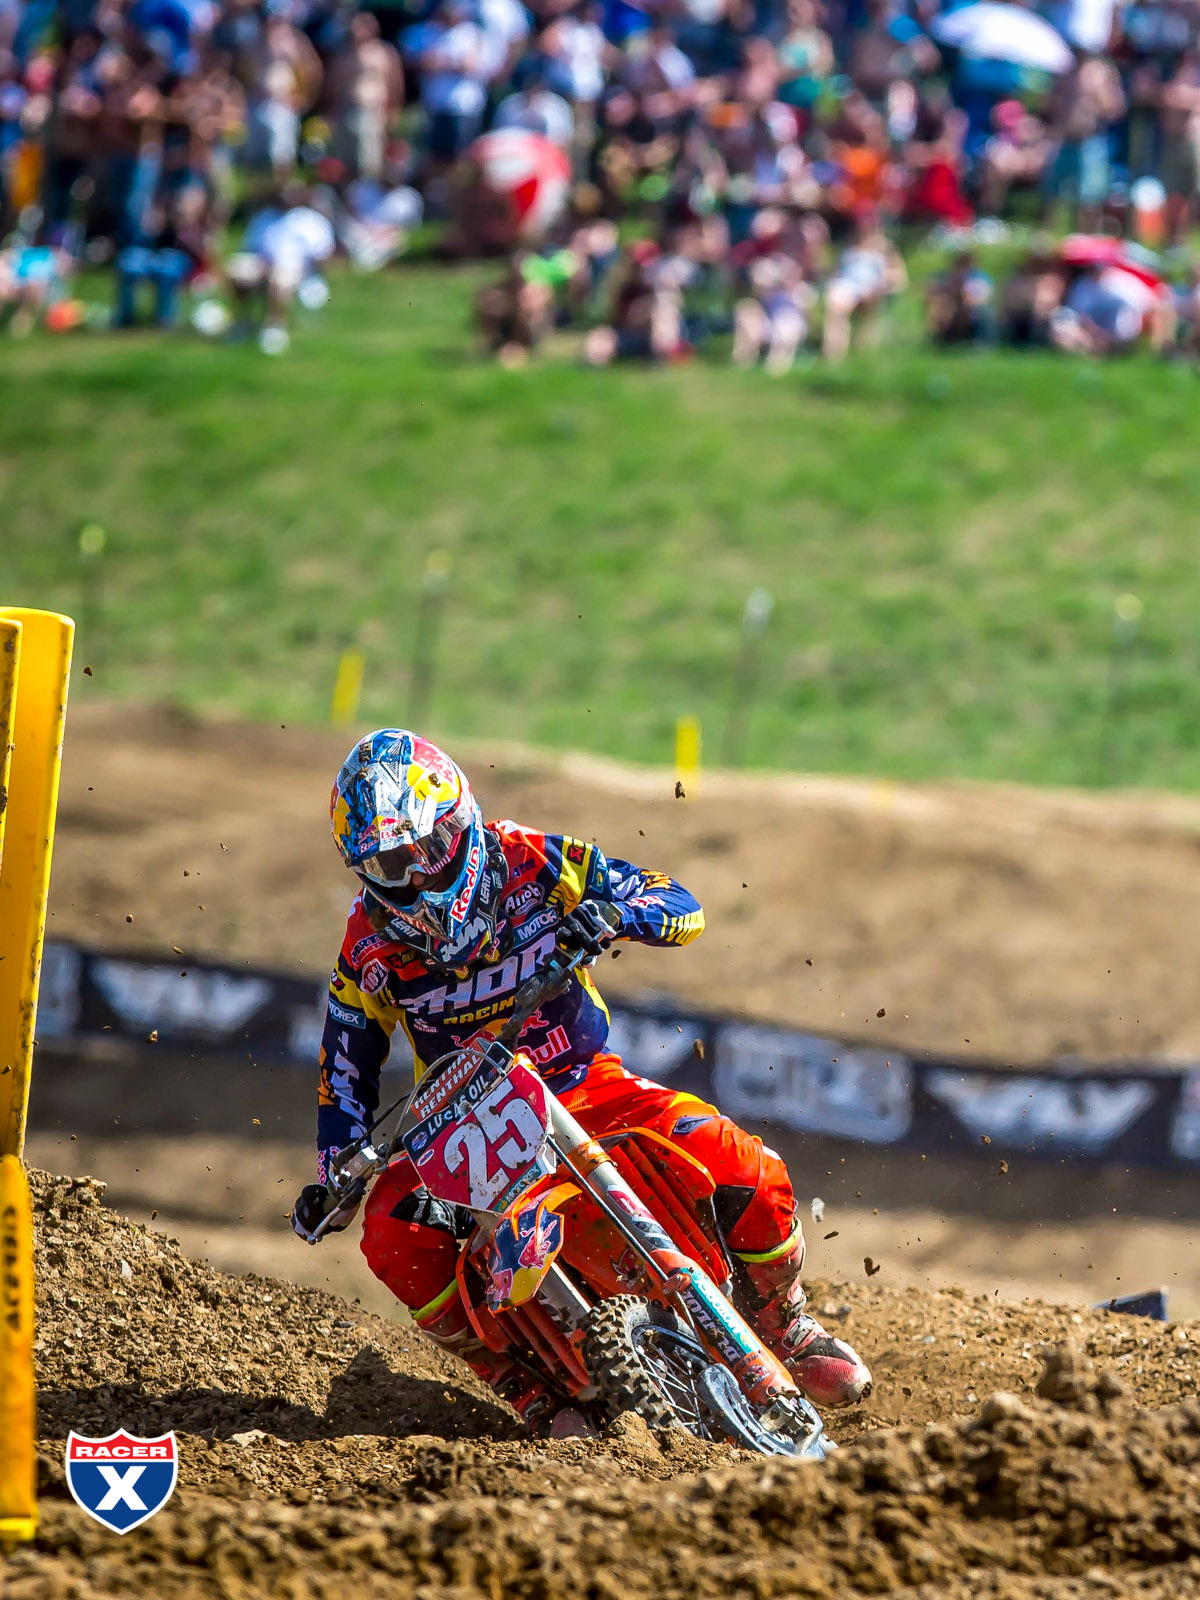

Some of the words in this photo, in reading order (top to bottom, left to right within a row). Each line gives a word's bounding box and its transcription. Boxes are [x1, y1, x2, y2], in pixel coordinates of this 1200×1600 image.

[450, 866, 478, 921] Red
[480, 870, 492, 904] LEATT
[505, 884, 541, 913] Airoh
[390, 917, 422, 938] LEATT
[440, 917, 487, 962] KTM
[399, 932, 555, 1015] THOR
[329, 1001, 359, 1024] TOREX
[443, 996, 516, 1025] RACIN
[513, 1025, 572, 1066] Bull
[413, 1046, 475, 1109] RENTHAL
[420, 1054, 482, 1118] RENTHAL
[469, 1075, 490, 1101] OIL
[443, 1076, 545, 1210] 25
